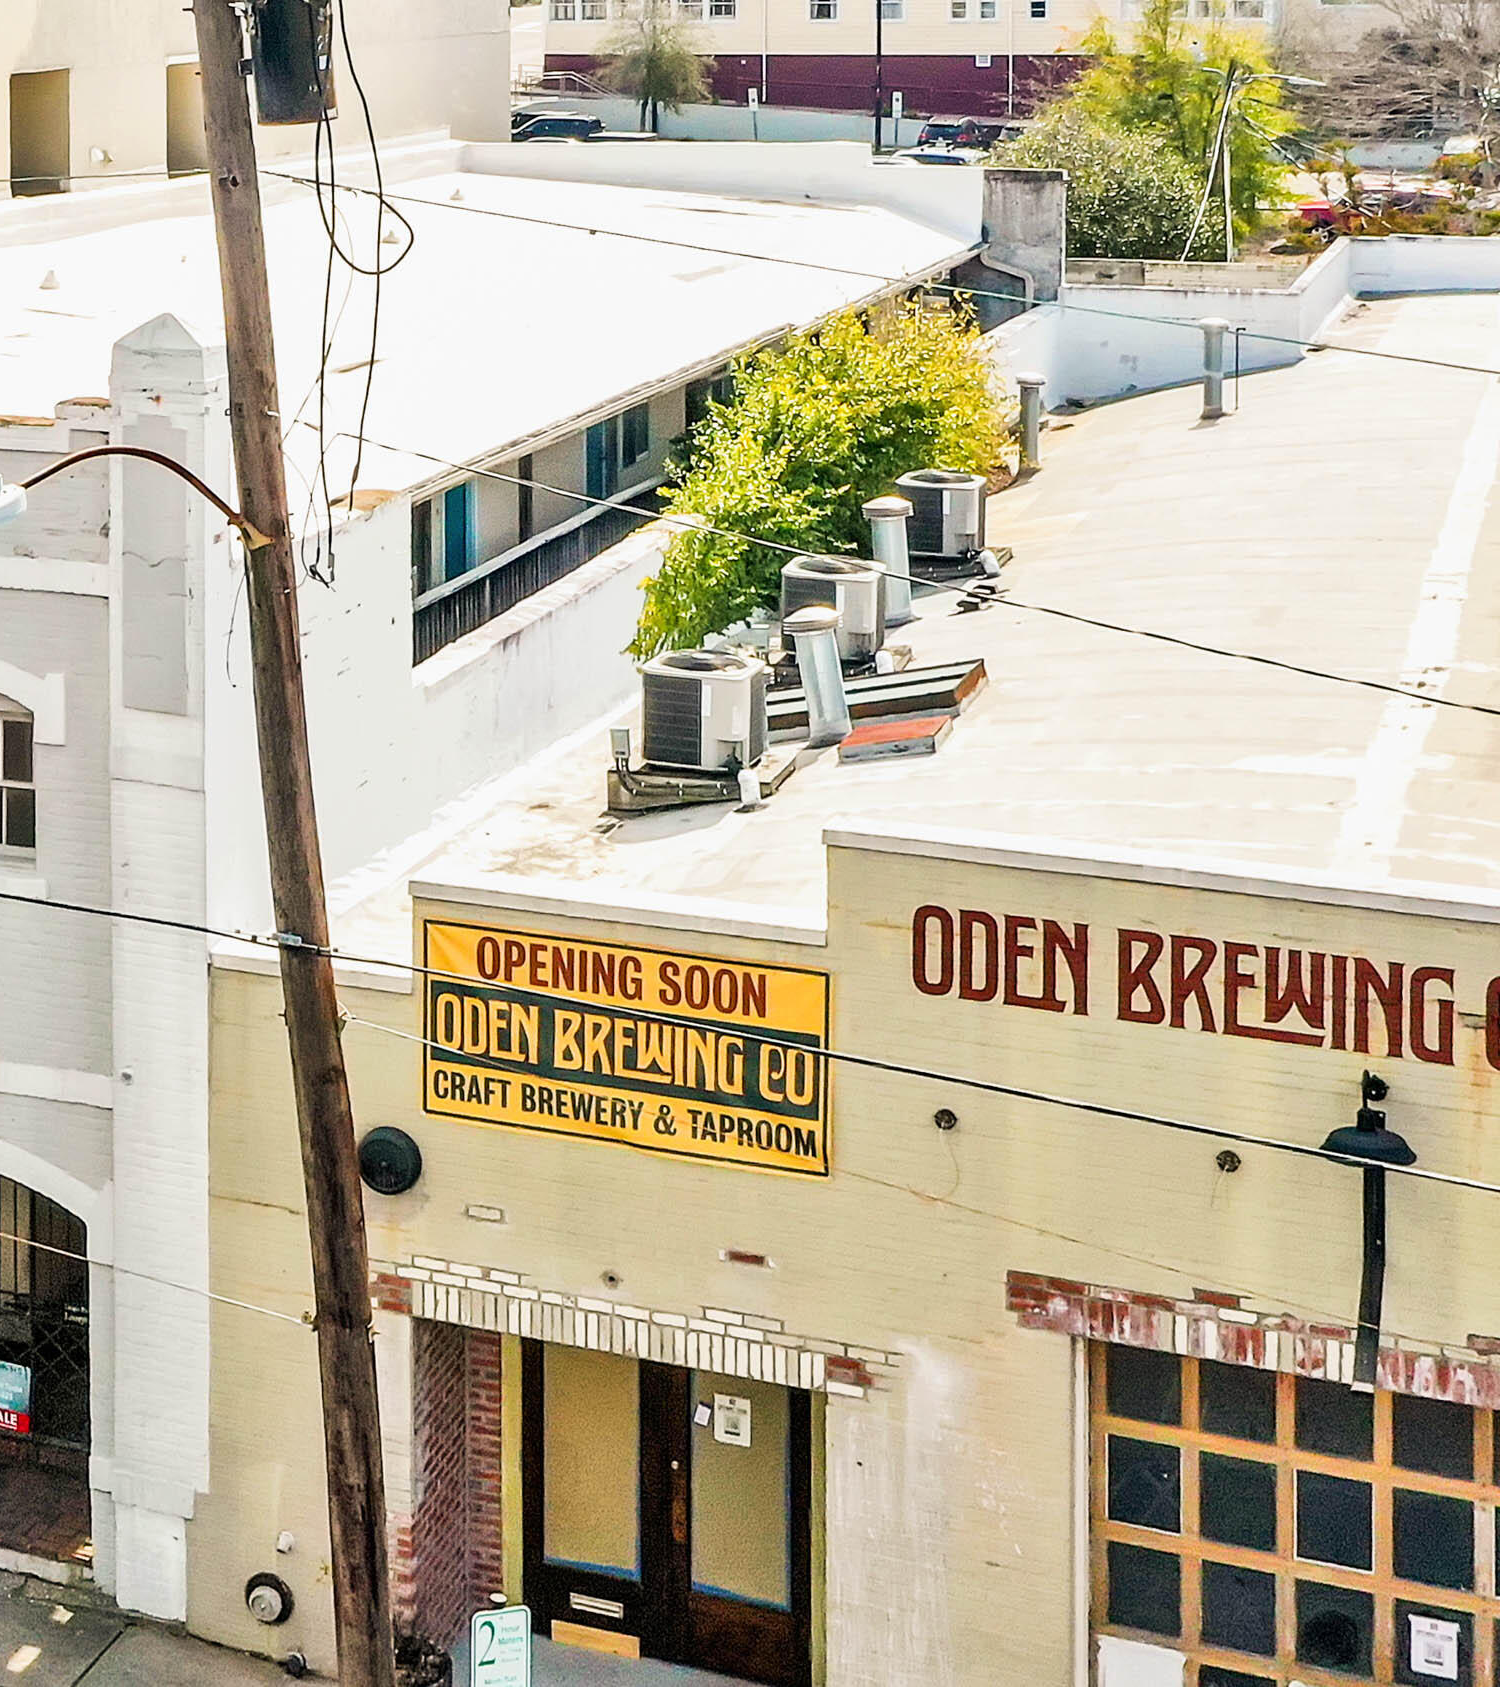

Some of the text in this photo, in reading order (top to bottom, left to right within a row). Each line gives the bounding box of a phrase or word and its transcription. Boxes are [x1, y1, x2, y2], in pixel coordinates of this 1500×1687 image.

[476, 936, 766, 1018] OPENING SOON
[912, 904, 1089, 1015] ODEN
[1116, 928, 1455, 1065] BREWING
[436, 992, 815, 1106] ODEN BREWING CO
[433, 1069, 818, 1158] CRAFT BREWERY & TAPROOM
[478, 1620, 496, 1667] 2
